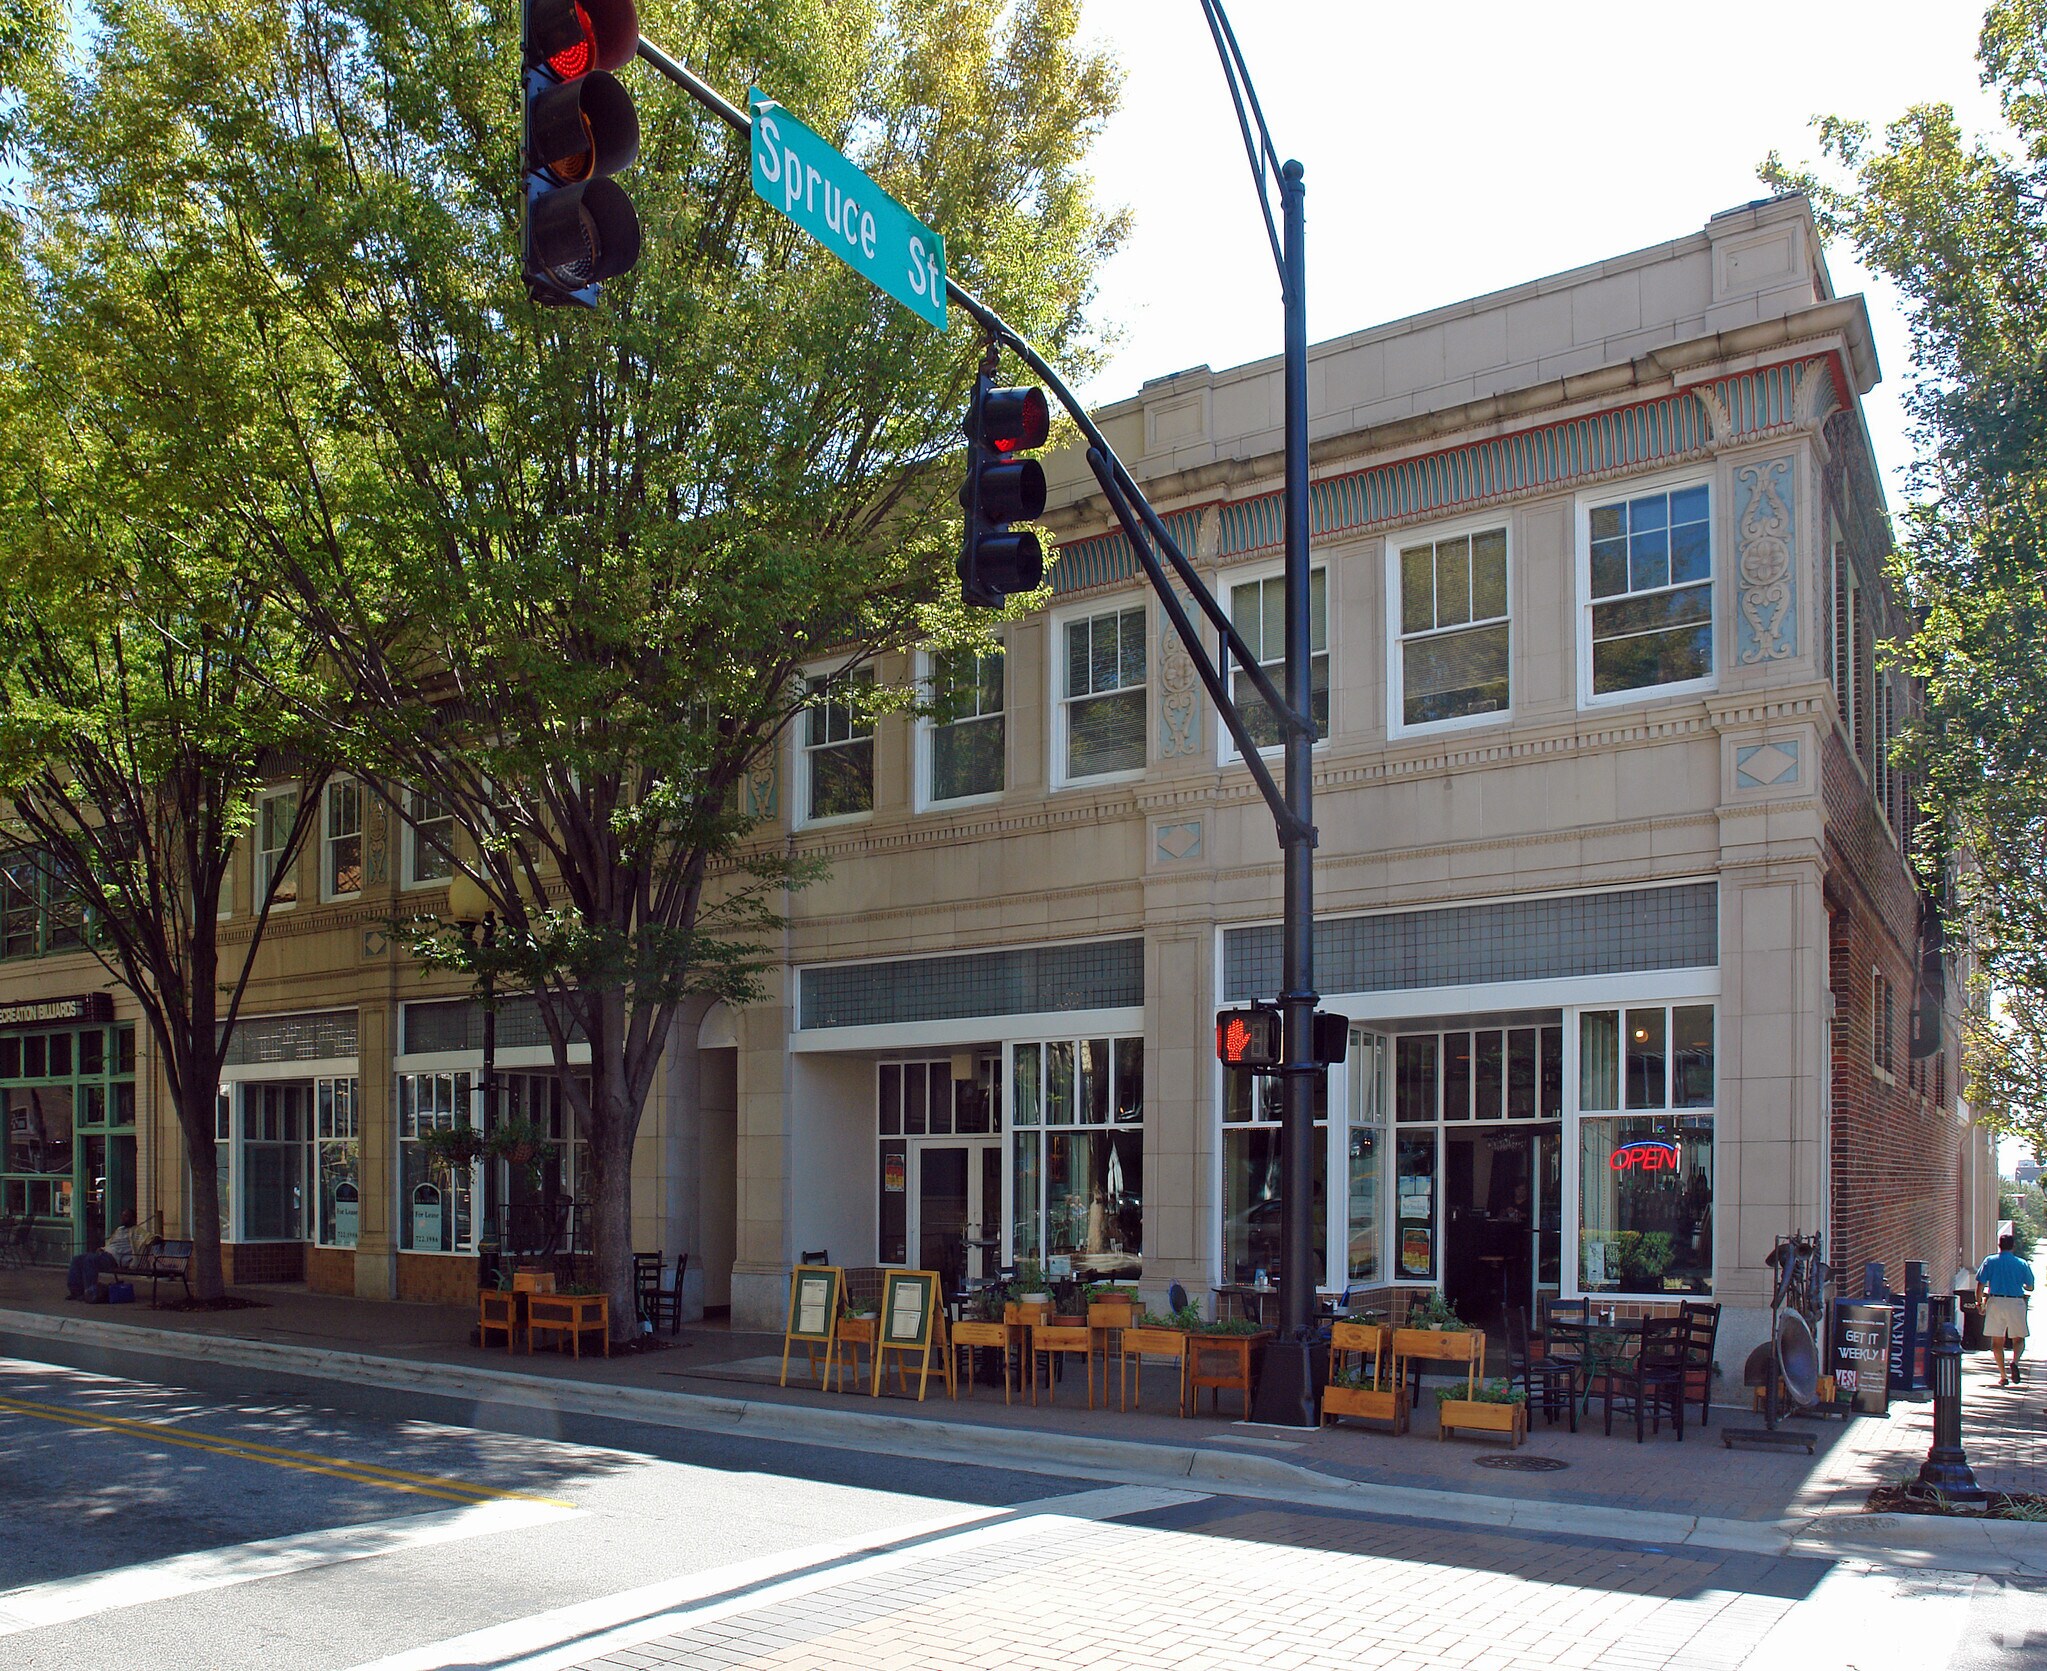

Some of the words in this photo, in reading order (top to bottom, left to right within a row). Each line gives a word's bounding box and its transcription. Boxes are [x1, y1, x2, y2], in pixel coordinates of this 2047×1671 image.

[758, 116, 877, 260] Spruce
[907, 235, 940, 308] St
[38, 1001, 77, 1019] BILLIARDS
[1609, 1147, 1679, 1170] OPEN
[425, 1211, 439, 1219] Lease
[1845, 1330, 1866, 1344] GET
[1868, 1333, 1879, 1345] IT
[1890, 1299, 1905, 1377] JOURNAL
[1838, 1347, 1879, 1362] WEEKLY
